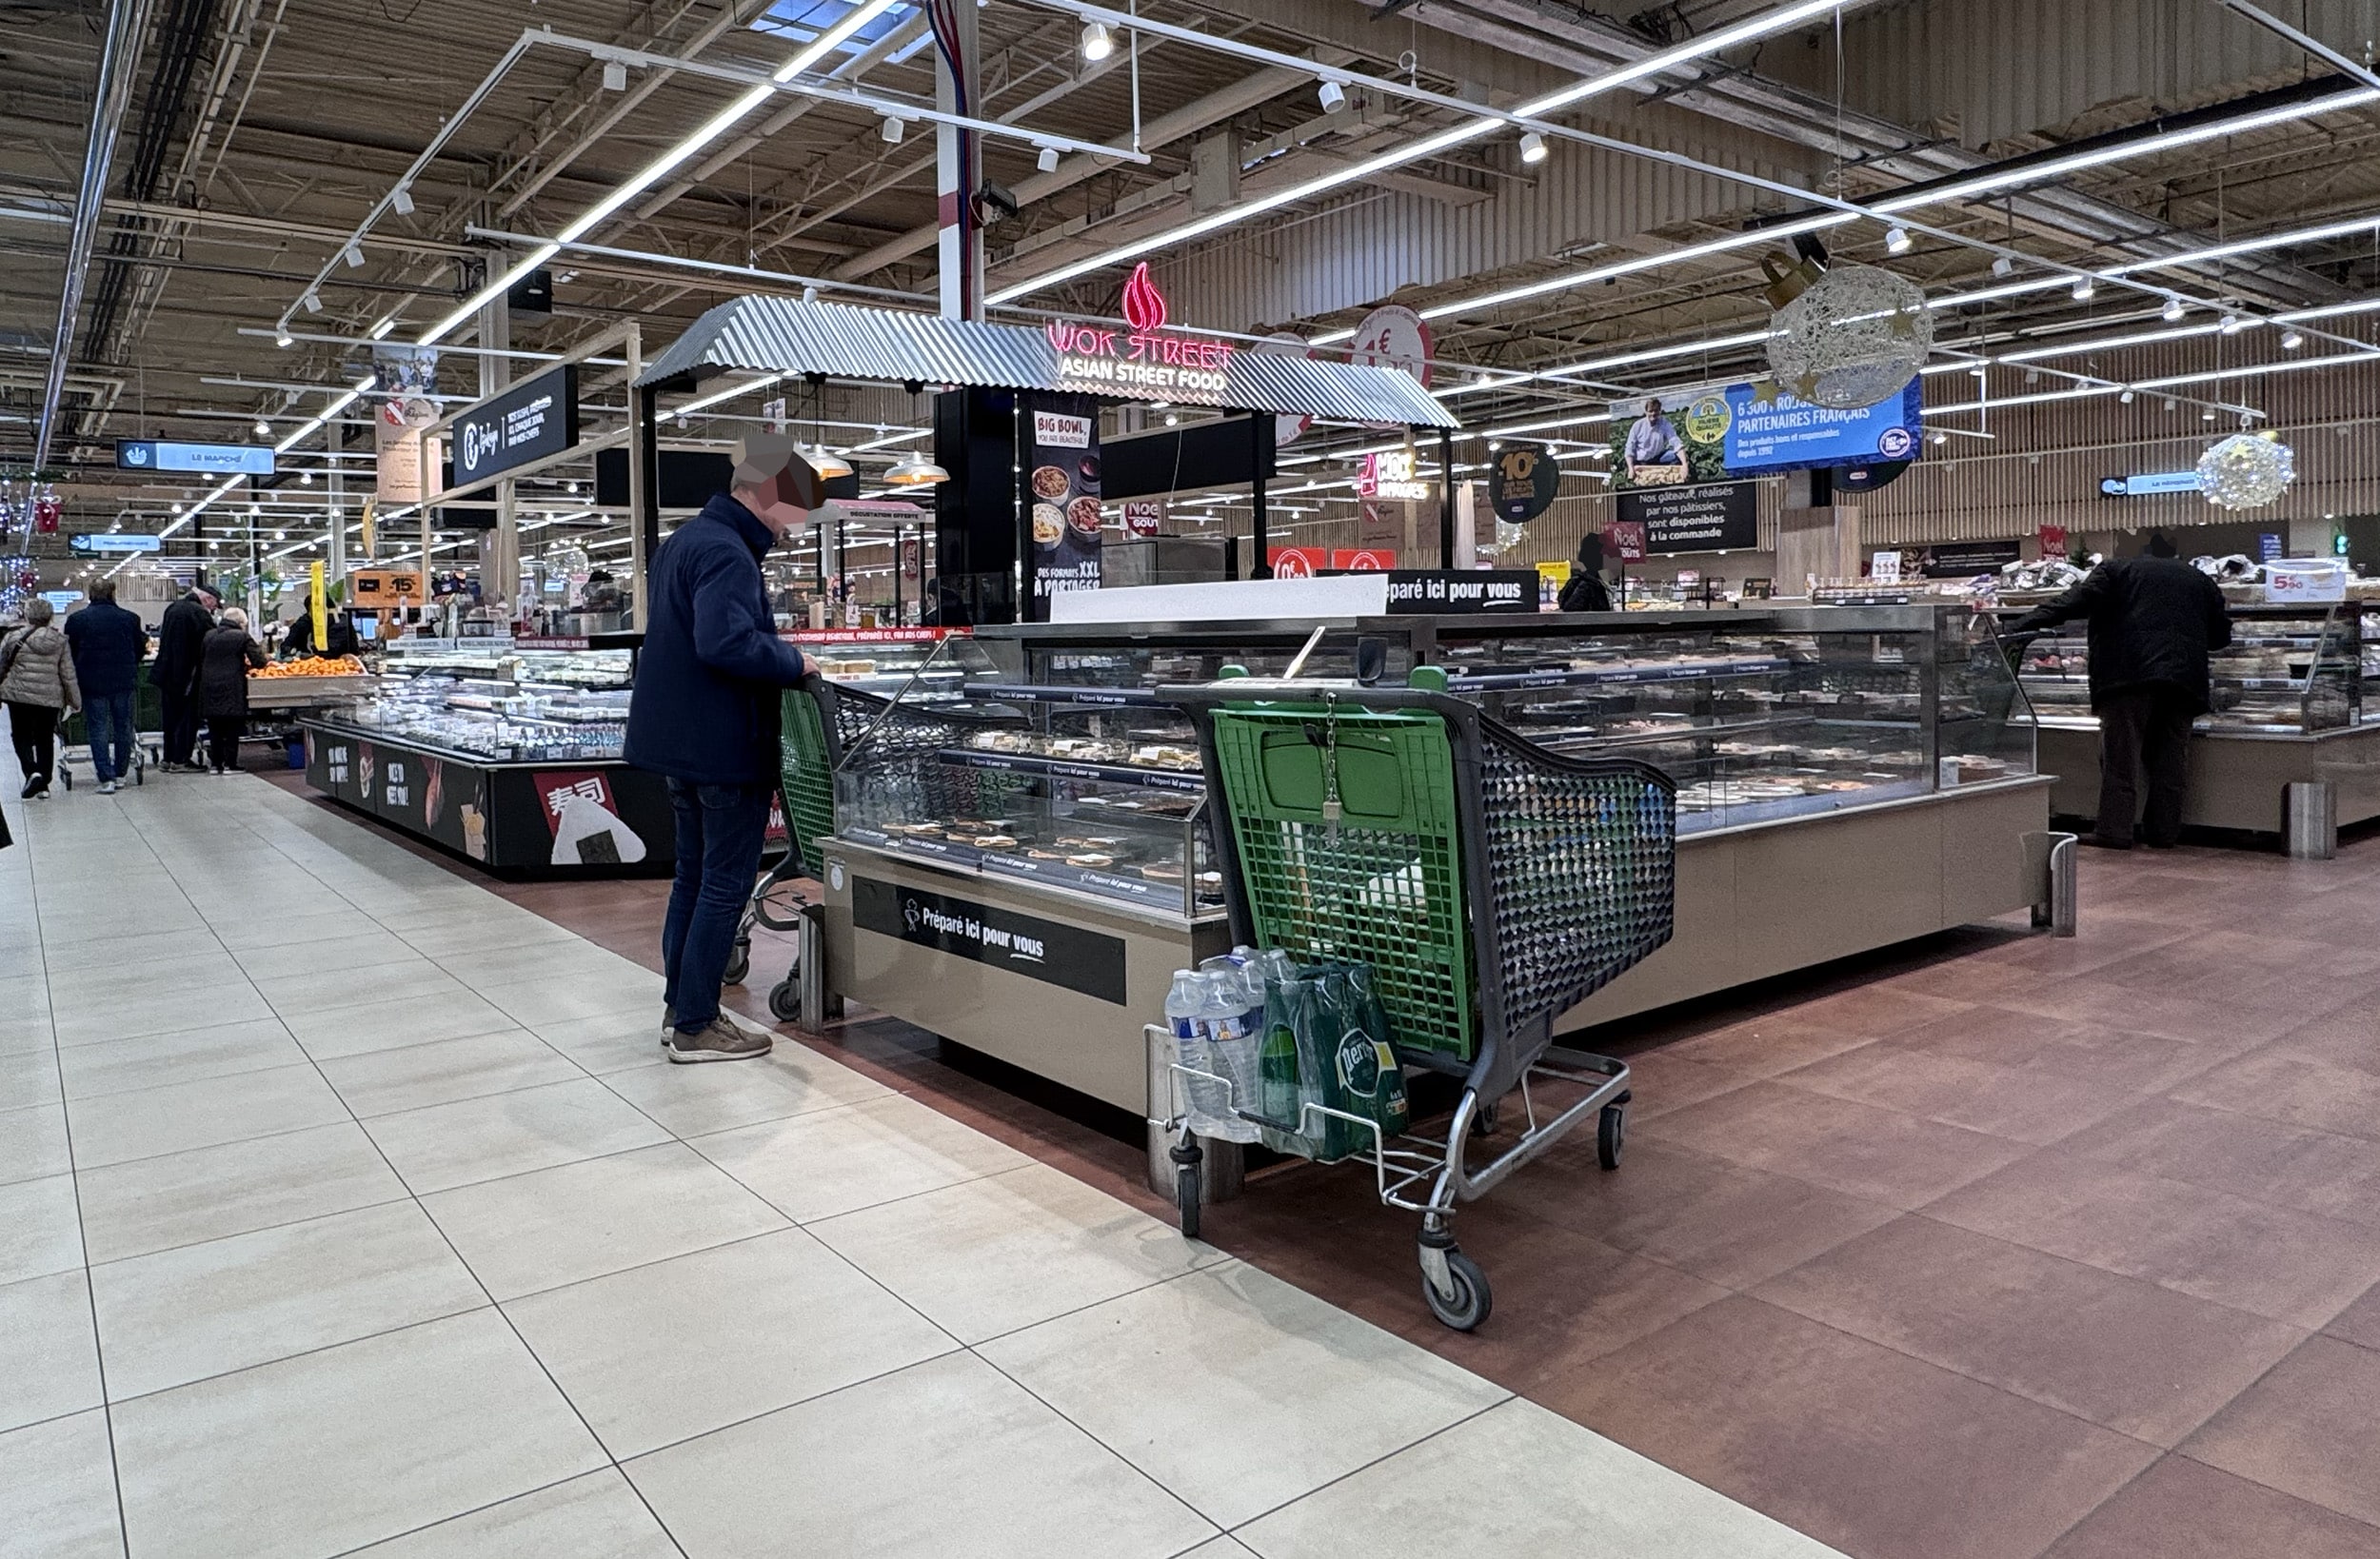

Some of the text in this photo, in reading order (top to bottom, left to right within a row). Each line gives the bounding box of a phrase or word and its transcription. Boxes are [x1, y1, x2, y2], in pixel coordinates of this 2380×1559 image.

[1048, 324, 1234, 369] WOK STREET
[1061, 357, 1227, 392] ASIAN STREET FOOD
[1737, 403, 1746, 416] 6
[1038, 417, 1087, 436] BIG BOWL,
[1737, 412, 1810, 434] PARTENAIRES
[1639, 493, 1656, 504] Nos
[1698, 486, 1734, 499] réalisés
[1646, 501, 1727, 518] par nos pâtissiers,
[1648, 514, 1725, 529] sont disponibles
[1650, 527, 1722, 542] à la commande
[1038, 567, 1049, 578] DES
[1080, 561, 1101, 579] XXL
[1034, 576, 1101, 597] À PARTAGER
[1386, 578, 1521, 603] paré ici pour vous
[922, 906, 1044, 958] Préparé ici pour vous
